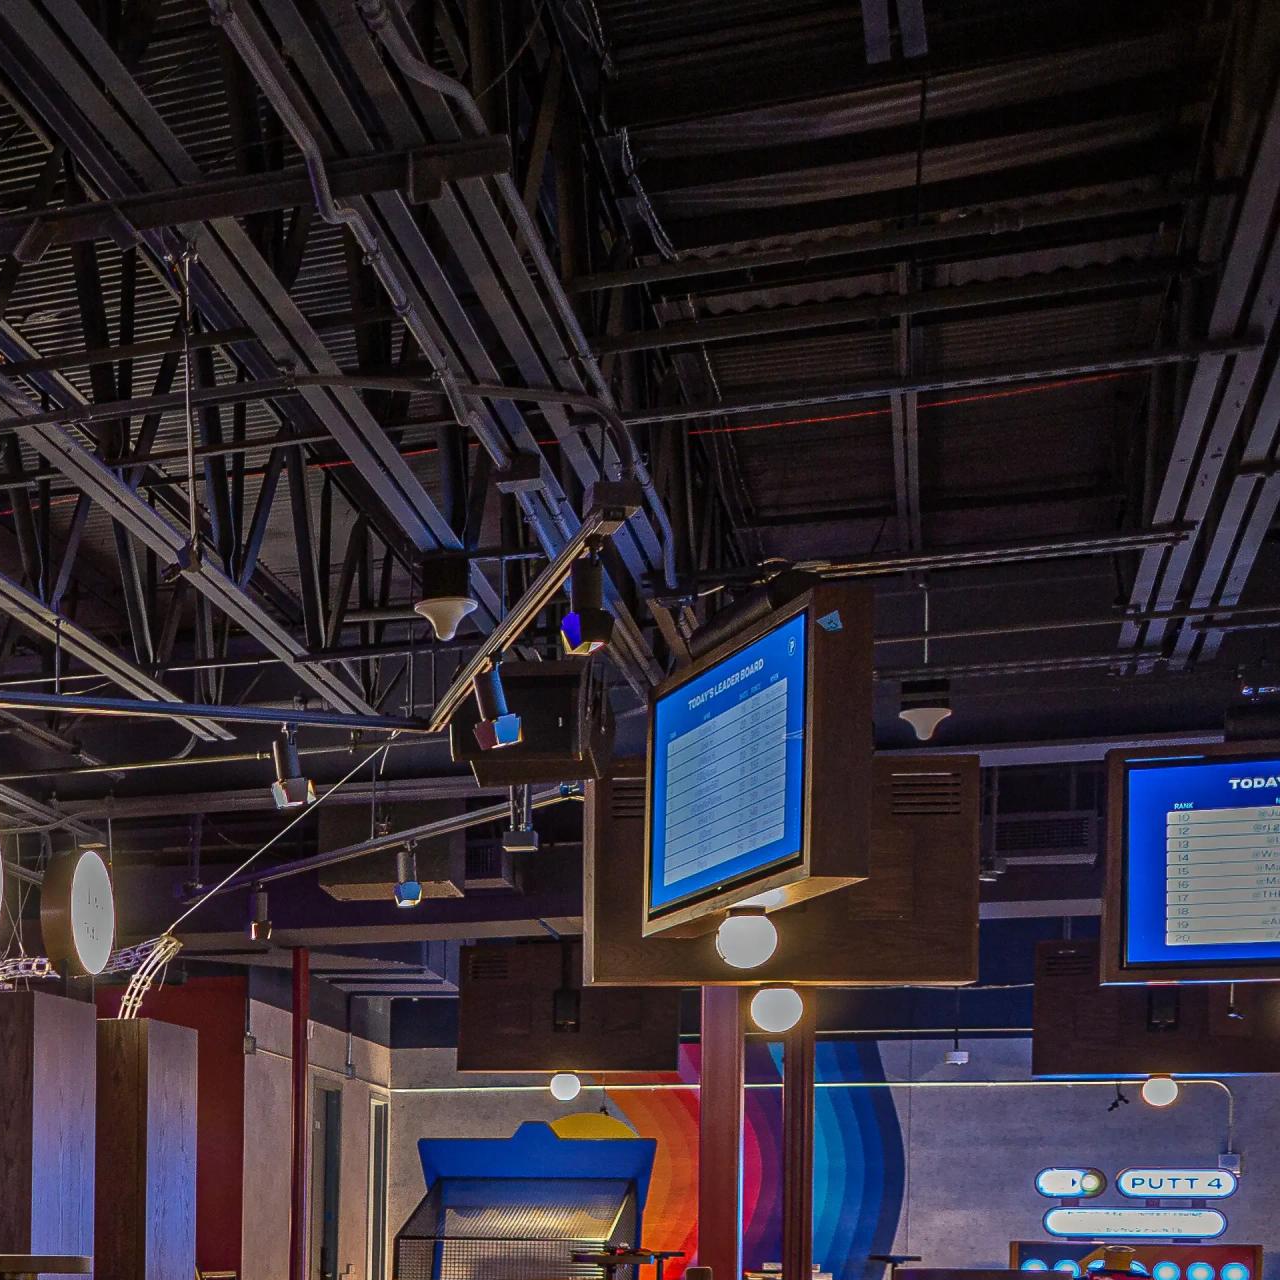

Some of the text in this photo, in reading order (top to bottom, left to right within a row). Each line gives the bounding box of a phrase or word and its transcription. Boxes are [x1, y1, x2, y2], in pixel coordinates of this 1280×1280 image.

[687, 691, 715, 711] TODAY'S
[714, 671, 741, 696] LEADER
[740, 657, 765, 682] BOARD
[1173, 802, 1195, 810] RANK
[1177, 826, 1191, 836] 12
[1177, 840, 1191, 849] 13
[1177, 853, 1191, 863] 14
[1177, 867, 1191, 876] 15
[1177, 880, 1191, 889] 16
[1177, 894, 1191, 903] 17
[1177, 907, 1191, 916] 18
[1177, 920, 1191, 930] 19
[1131, 1177, 1223, 1190] PUTT 4
